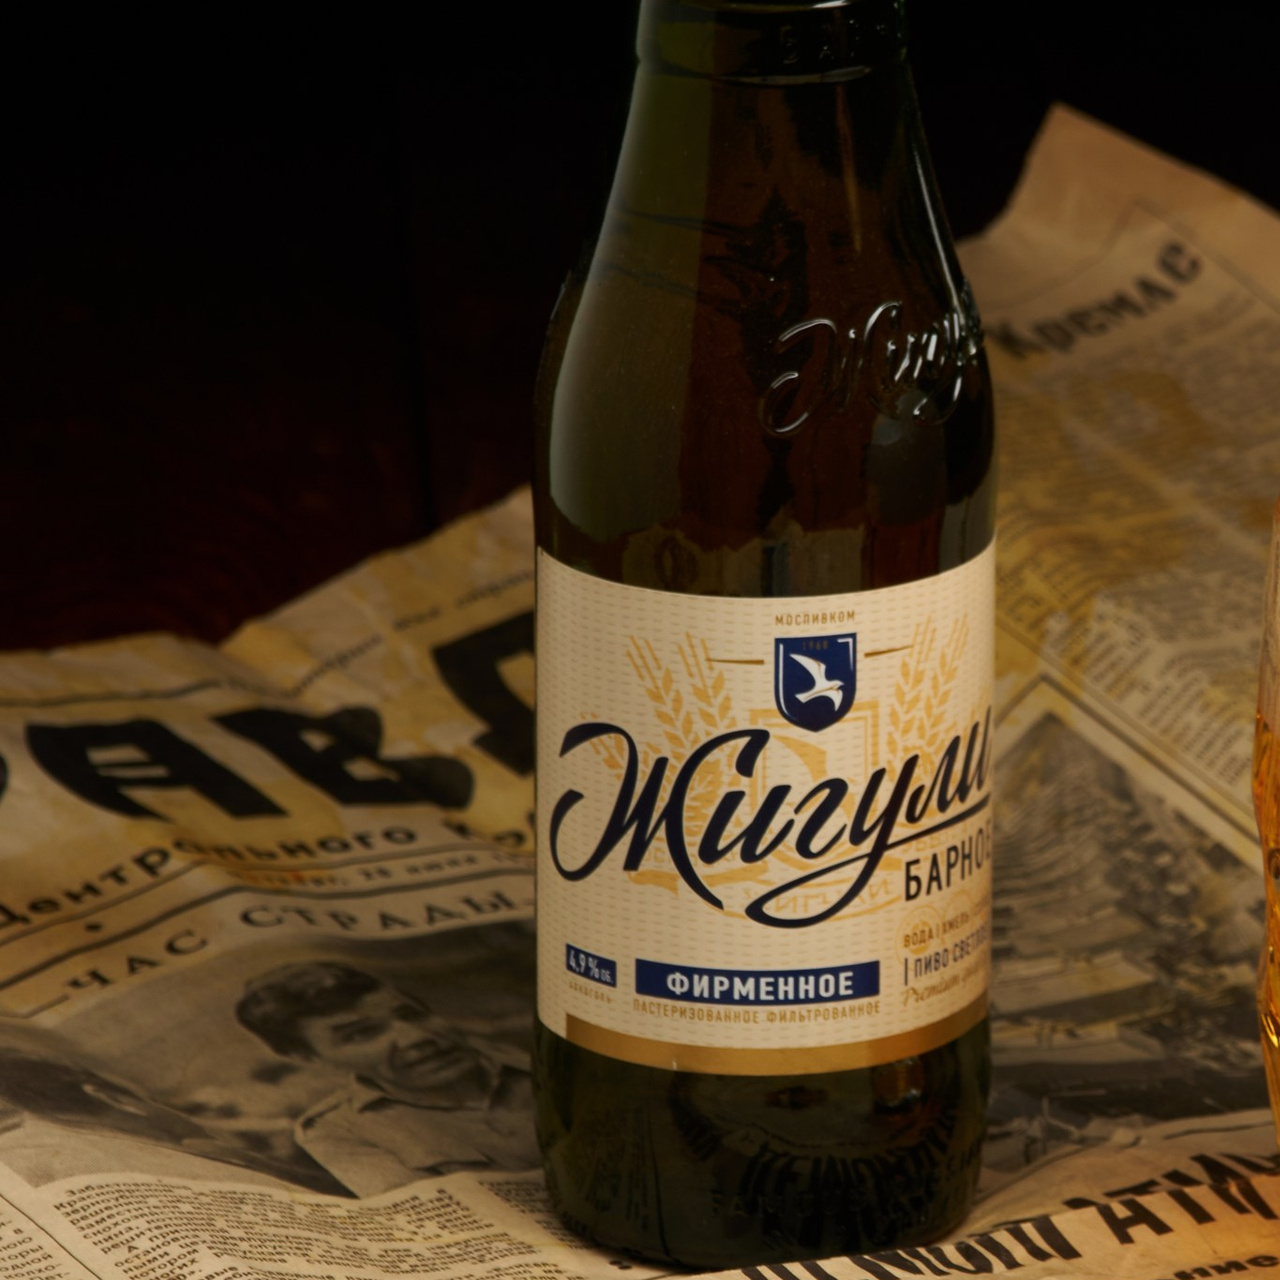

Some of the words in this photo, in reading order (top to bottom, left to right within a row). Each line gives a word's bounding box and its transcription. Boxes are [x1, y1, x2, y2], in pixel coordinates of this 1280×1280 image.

[775, 610, 855, 626] МОСПИВКОМ
[548, 705, 994, 928] Жигули
[903, 928, 934, 949] ВОДА
[67, 929, 208, 992] ЧАС
[914, 948, 948, 979] ПИВО
[666, 972, 854, 1001] ФИРМЕННОЕ
[633, 998, 759, 1024] ПАСТЕРИЗОВАННОЕ
[766, 1001, 881, 1024] ФИЛЬТРОВАННОЕ
